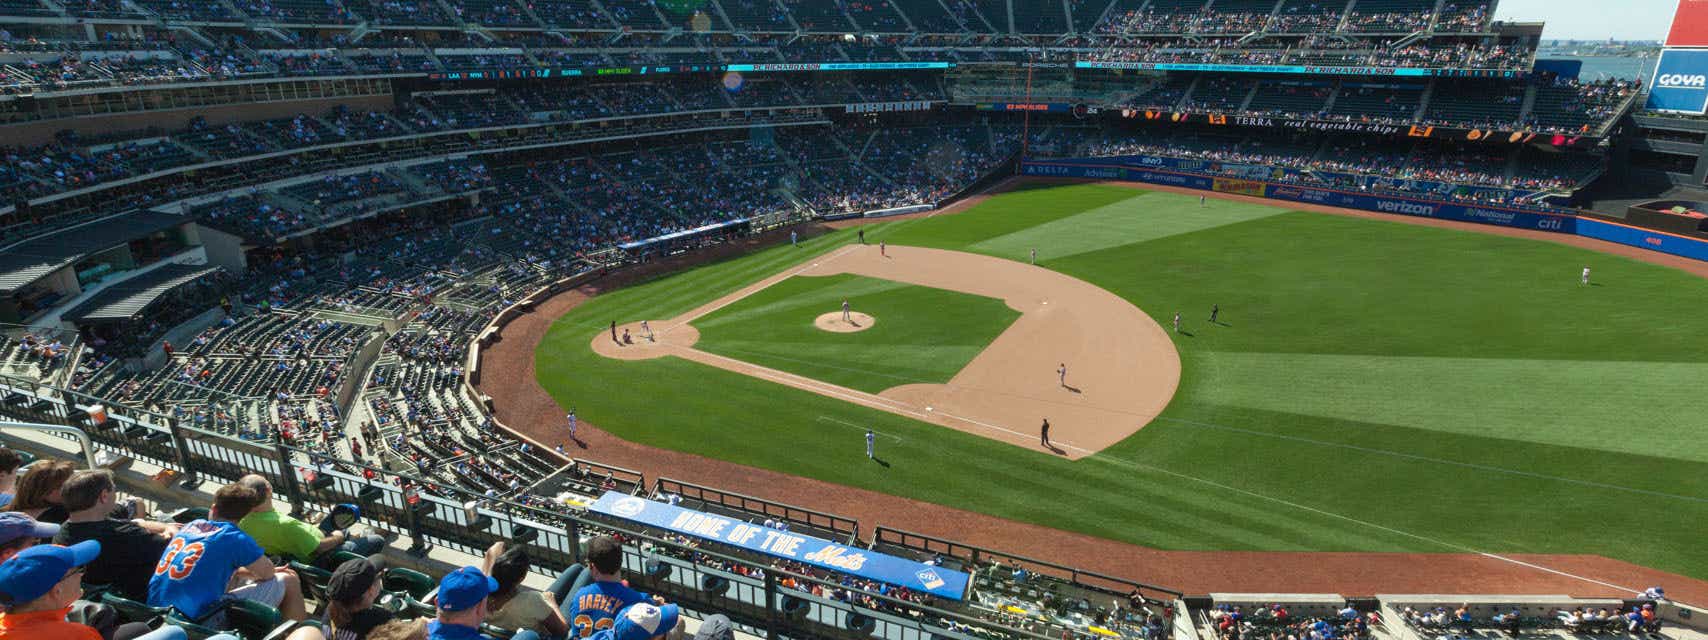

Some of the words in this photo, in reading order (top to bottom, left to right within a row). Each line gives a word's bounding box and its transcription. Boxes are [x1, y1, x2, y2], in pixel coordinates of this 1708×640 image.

[1319, 67, 1364, 75] RICHARD
[1375, 68, 1395, 76] SON
[1659, 74, 1706, 86] GOYA
[1235, 116, 1273, 127] TERRA
[1284, 119, 1305, 129] real
[1310, 120, 1362, 132] vegetable
[1367, 124, 1398, 134] chips
[1037, 165, 1069, 175] DELTA
[1377, 200, 1433, 215] verizon
[1475, 208, 1516, 220] National
[1538, 218, 1561, 230] citi
[670, 510, 731, 539] HOME
[727, 523, 762, 546] OF
[759, 529, 806, 557] THE
[804, 544, 868, 571] Mets
[155, 537, 205, 581] 33
[578, 593, 624, 614] HARVEY
